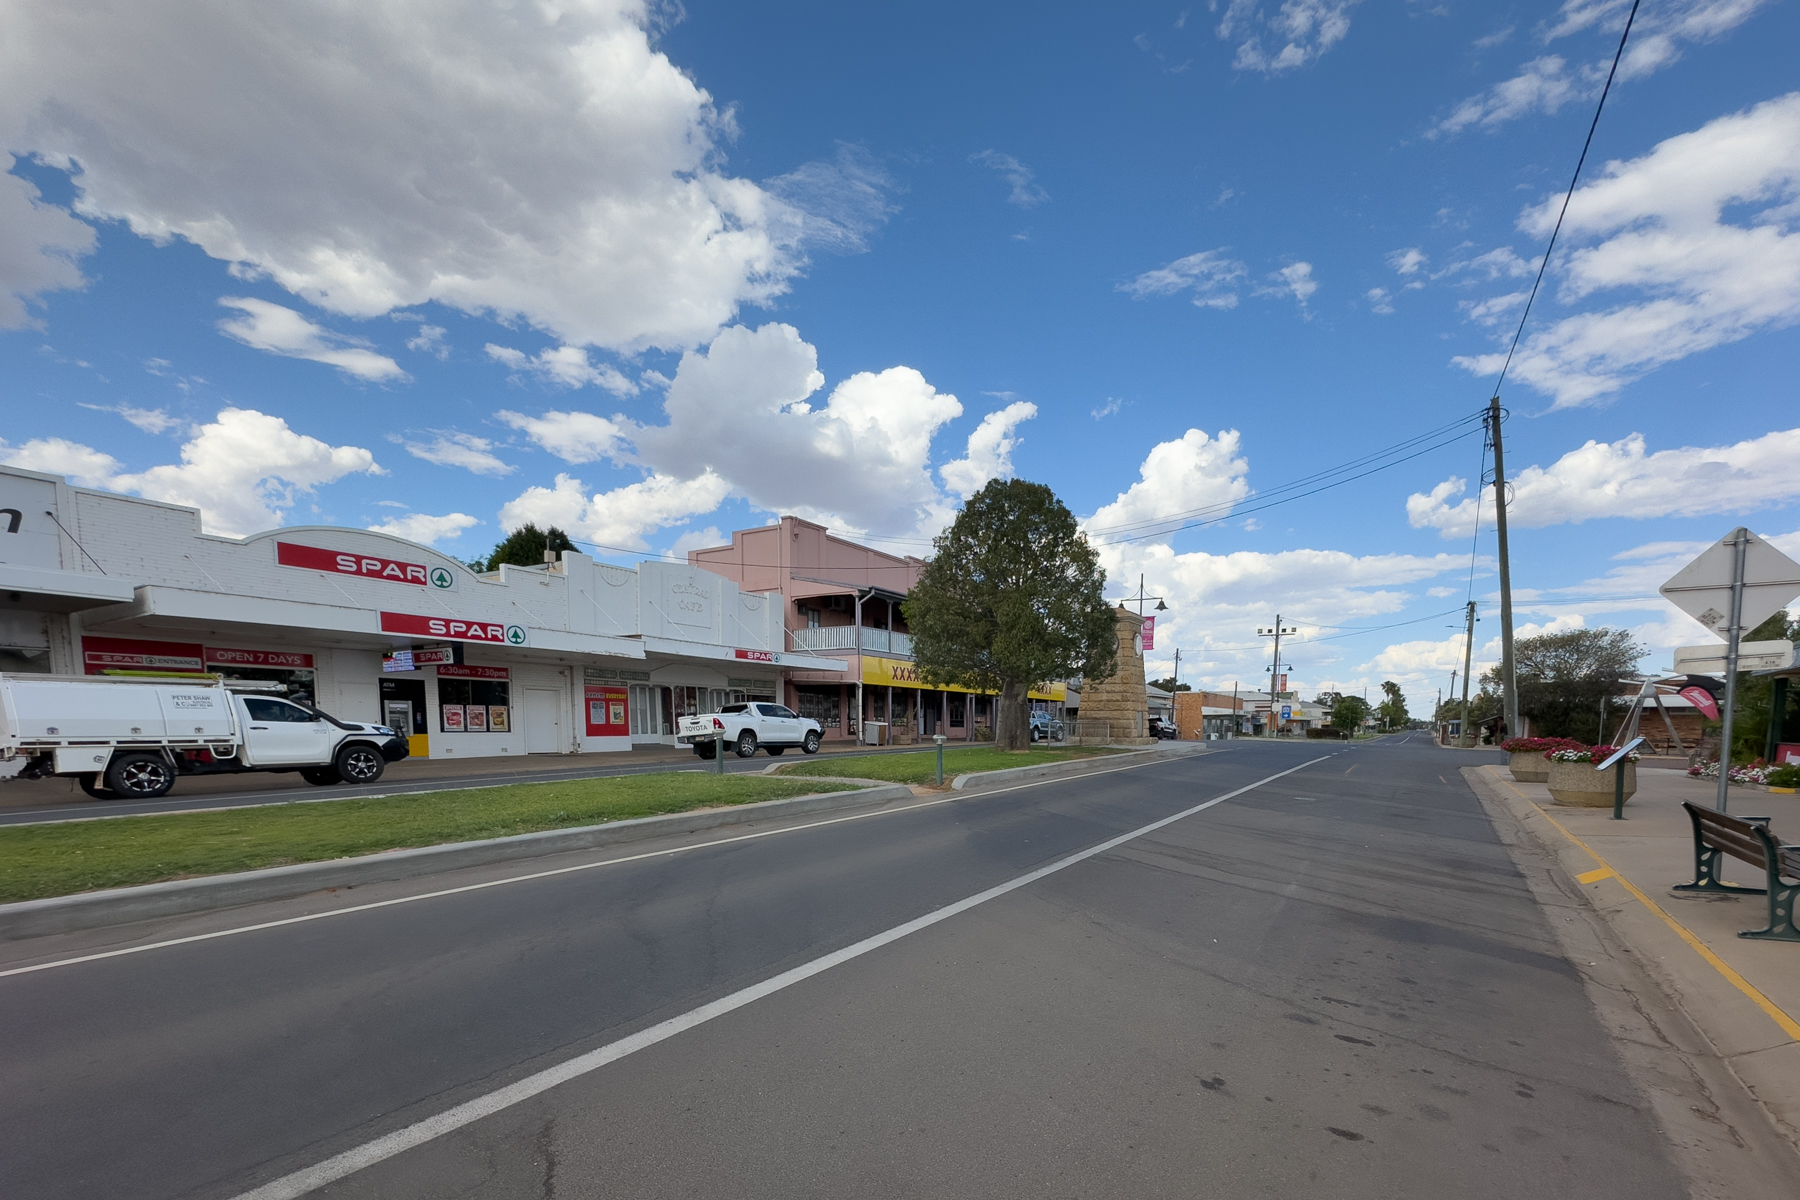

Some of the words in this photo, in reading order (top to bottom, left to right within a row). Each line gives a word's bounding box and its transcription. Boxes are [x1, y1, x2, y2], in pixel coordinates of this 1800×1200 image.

[336, 554, 426, 582] SPAR
[429, 619, 504, 640] SPAR
[102, 655, 143, 663] SPAR
[157, 657, 200, 666] ENTRANCE
[216, 651, 254, 662] OPEN
[257, 653, 264, 662] 7
[268, 654, 301, 664] DAYS
[420, 652, 443, 661] SPAR
[747, 651, 772, 660] SPAR
[439, 666, 470, 675] 6:30am
[477, 668, 507, 678] 7:30pm
[892, 666, 920, 682] XXXX
[685, 724, 708, 732] TOYOTA
